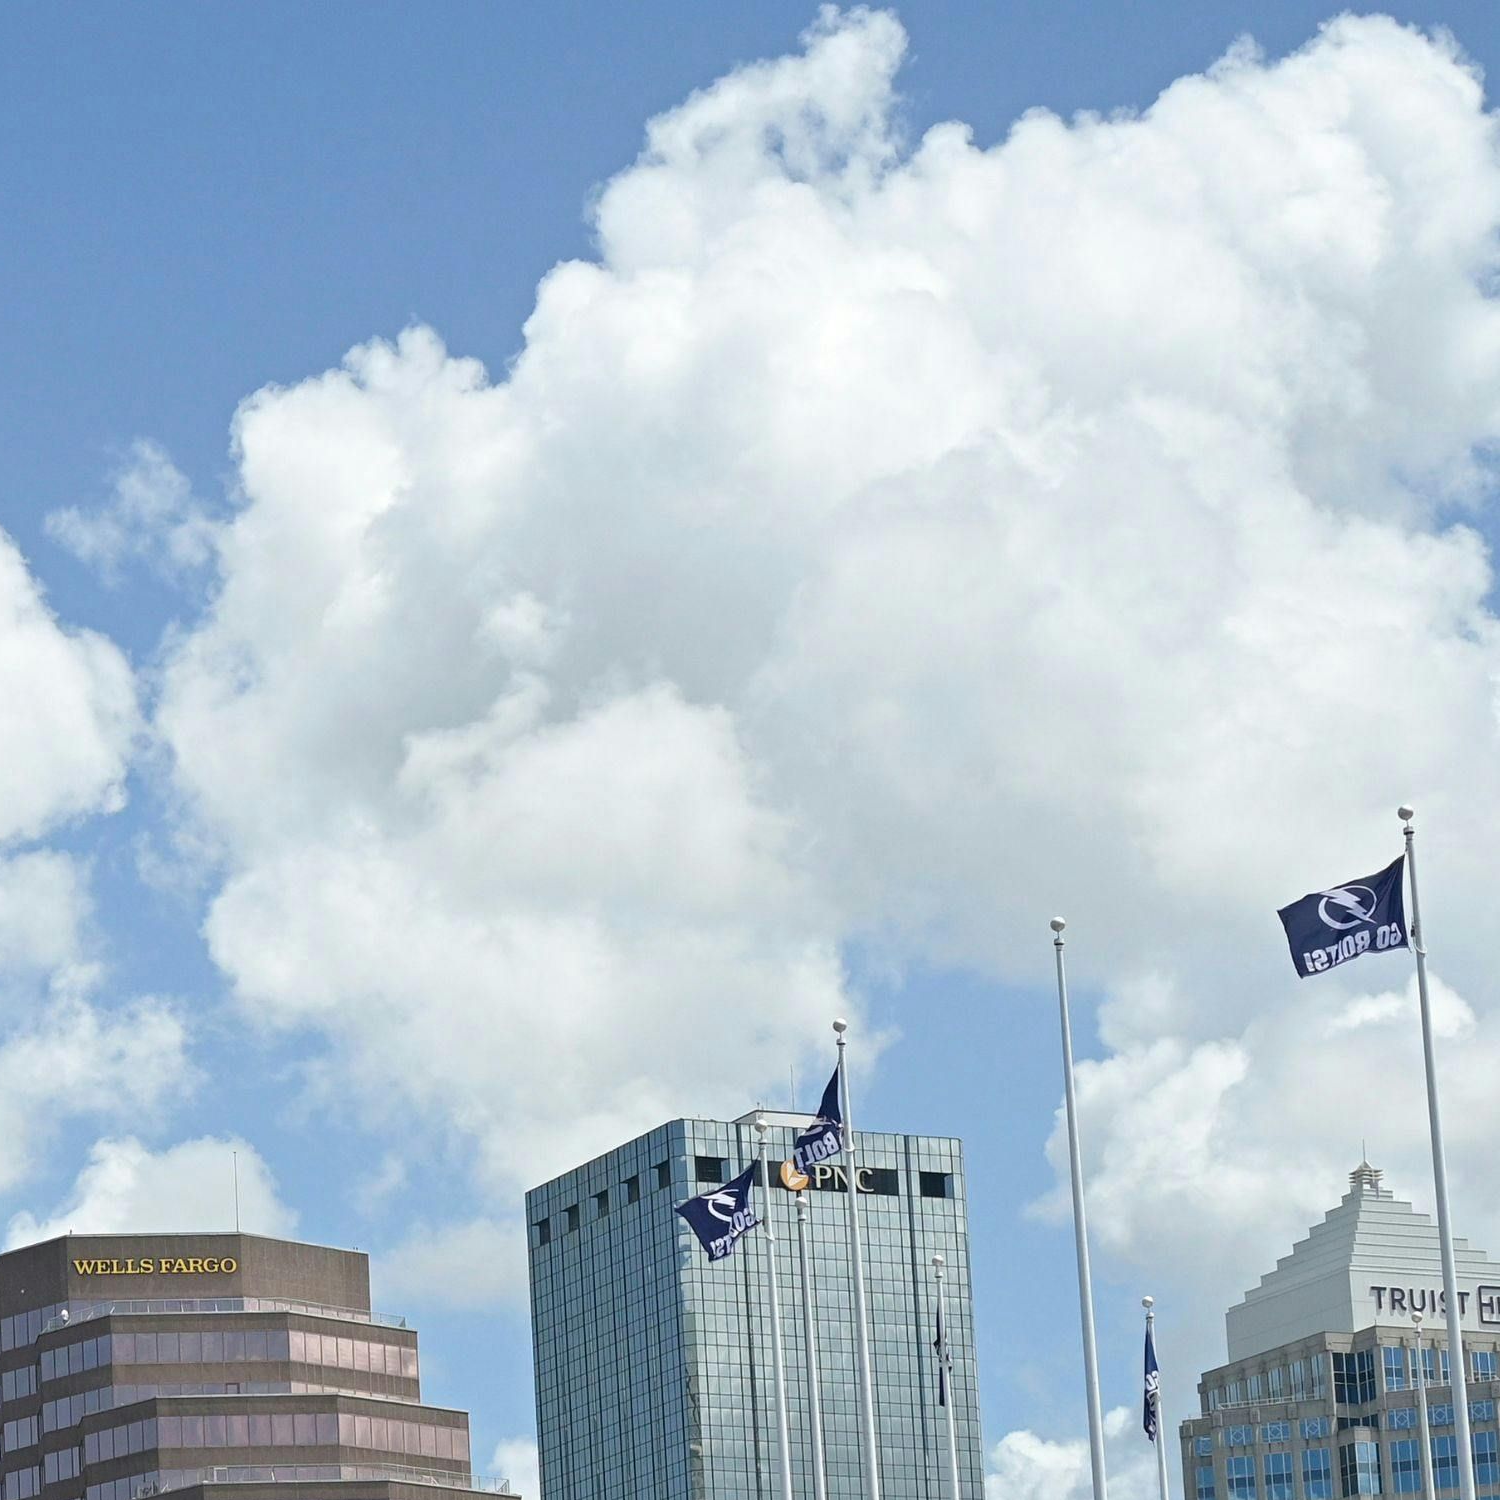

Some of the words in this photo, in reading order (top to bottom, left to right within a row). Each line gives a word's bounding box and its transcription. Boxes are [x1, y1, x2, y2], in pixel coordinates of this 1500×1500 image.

[812, 1165, 875, 1193] PNC
[73, 1259, 154, 1275] WELLS
[159, 1257, 237, 1275] FARGO
